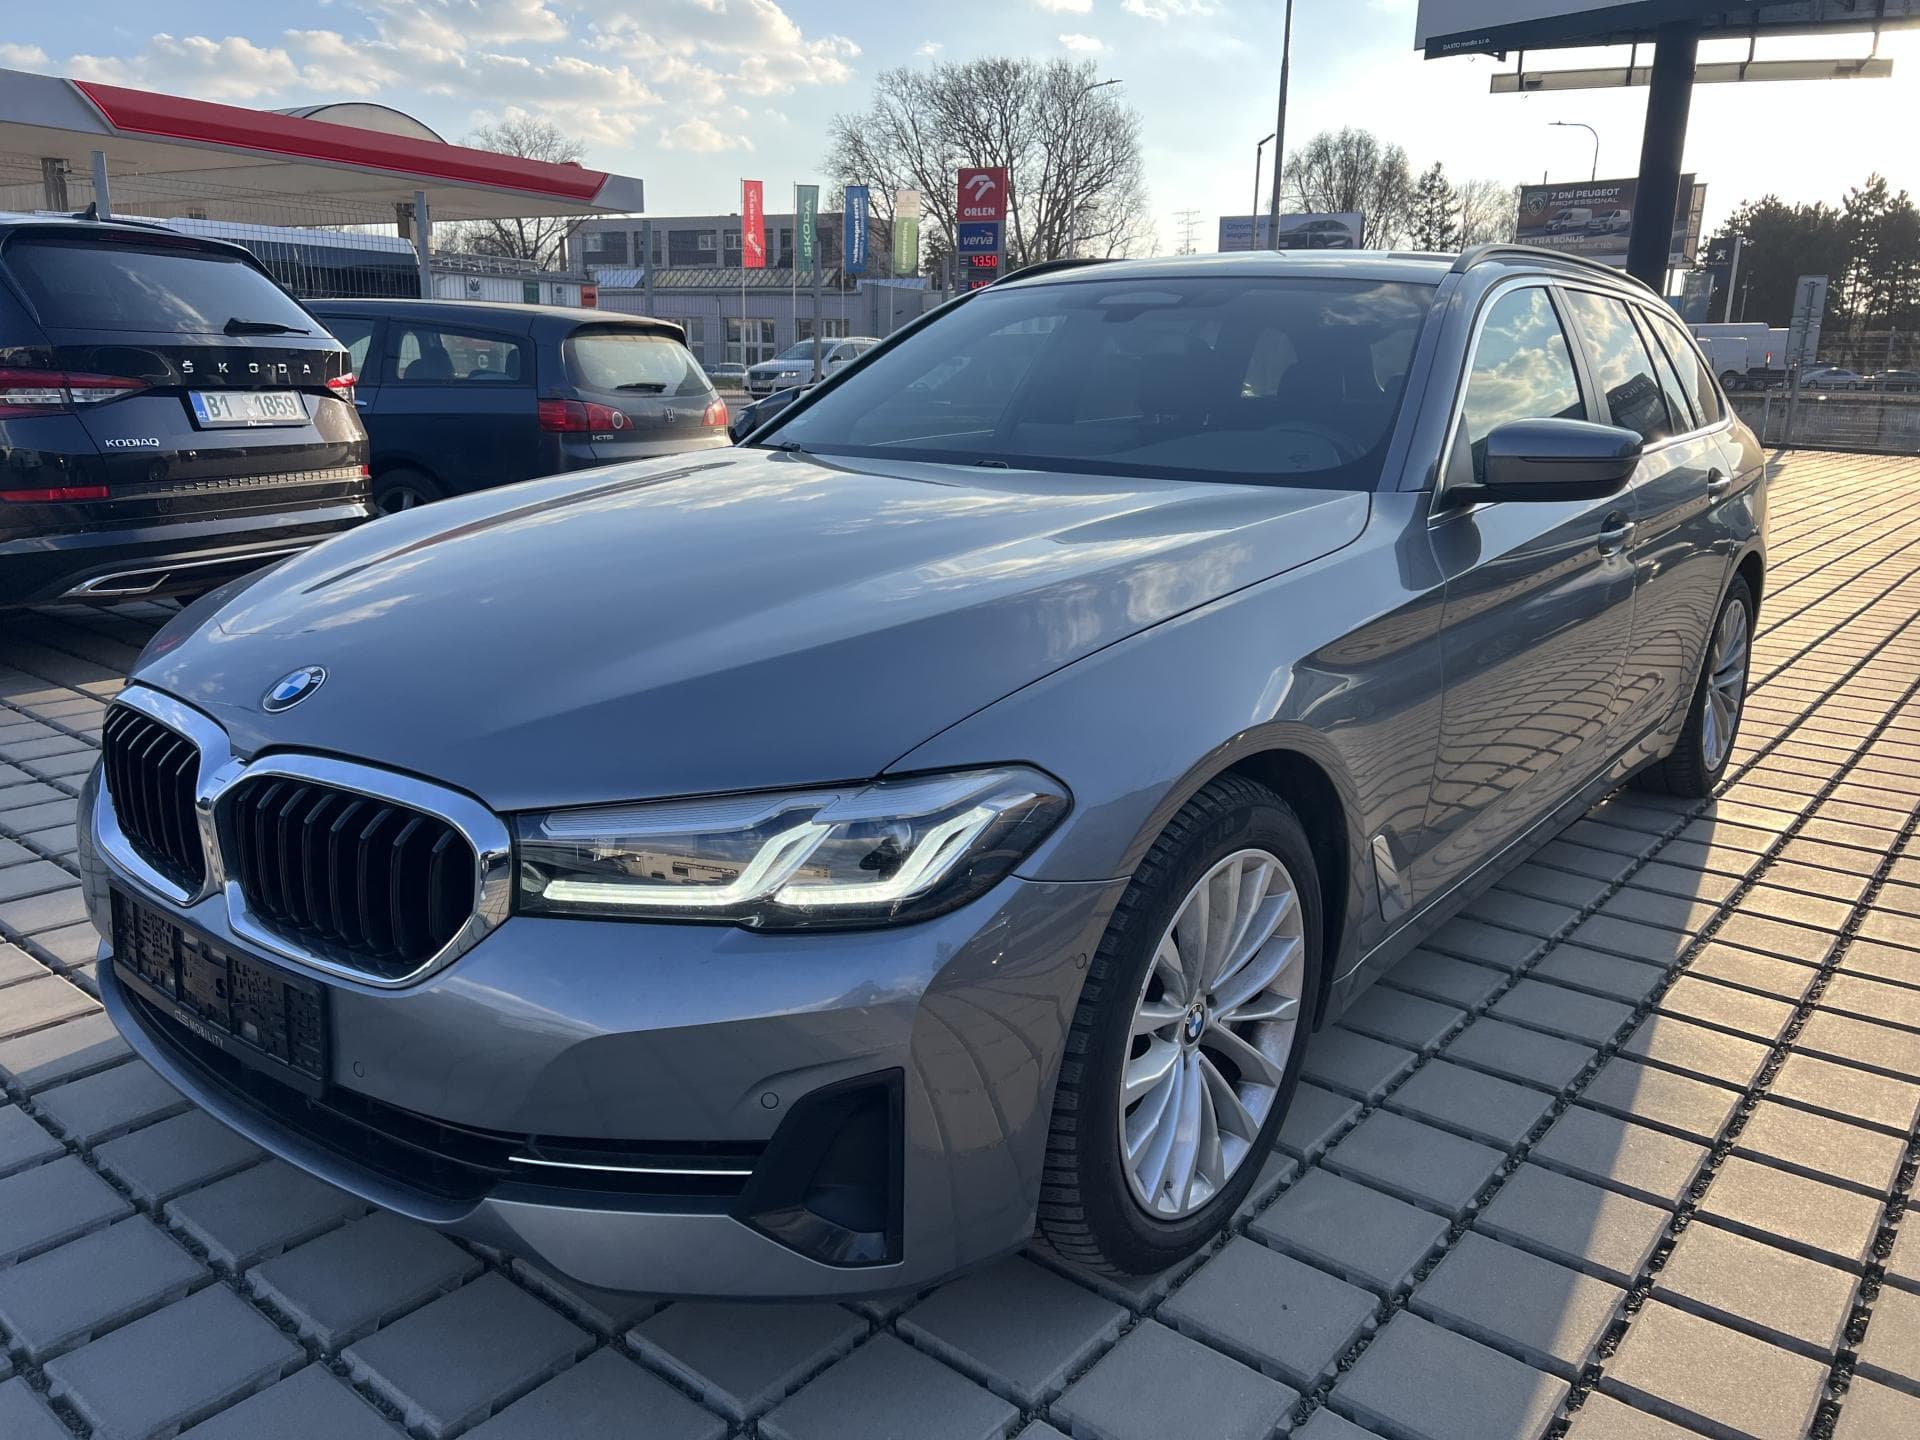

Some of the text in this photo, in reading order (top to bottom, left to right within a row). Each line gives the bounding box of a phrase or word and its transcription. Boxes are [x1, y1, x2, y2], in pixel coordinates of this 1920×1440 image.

[1551, 187, 1620, 200] 7 DNÍ PEUGEOT
[1549, 197, 1619, 207] PROFESSIONAL
[963, 207, 995, 217] ORLEN
[852, 220, 861, 264] Volkswagen
[962, 235, 994, 246] verva
[1521, 235, 1585, 245] EXTRA BONUS
[182, 360, 312, 375] ŠKODA
[205, 394, 298, 418] B1 1859
[105, 437, 160, 449] KODIAQ
